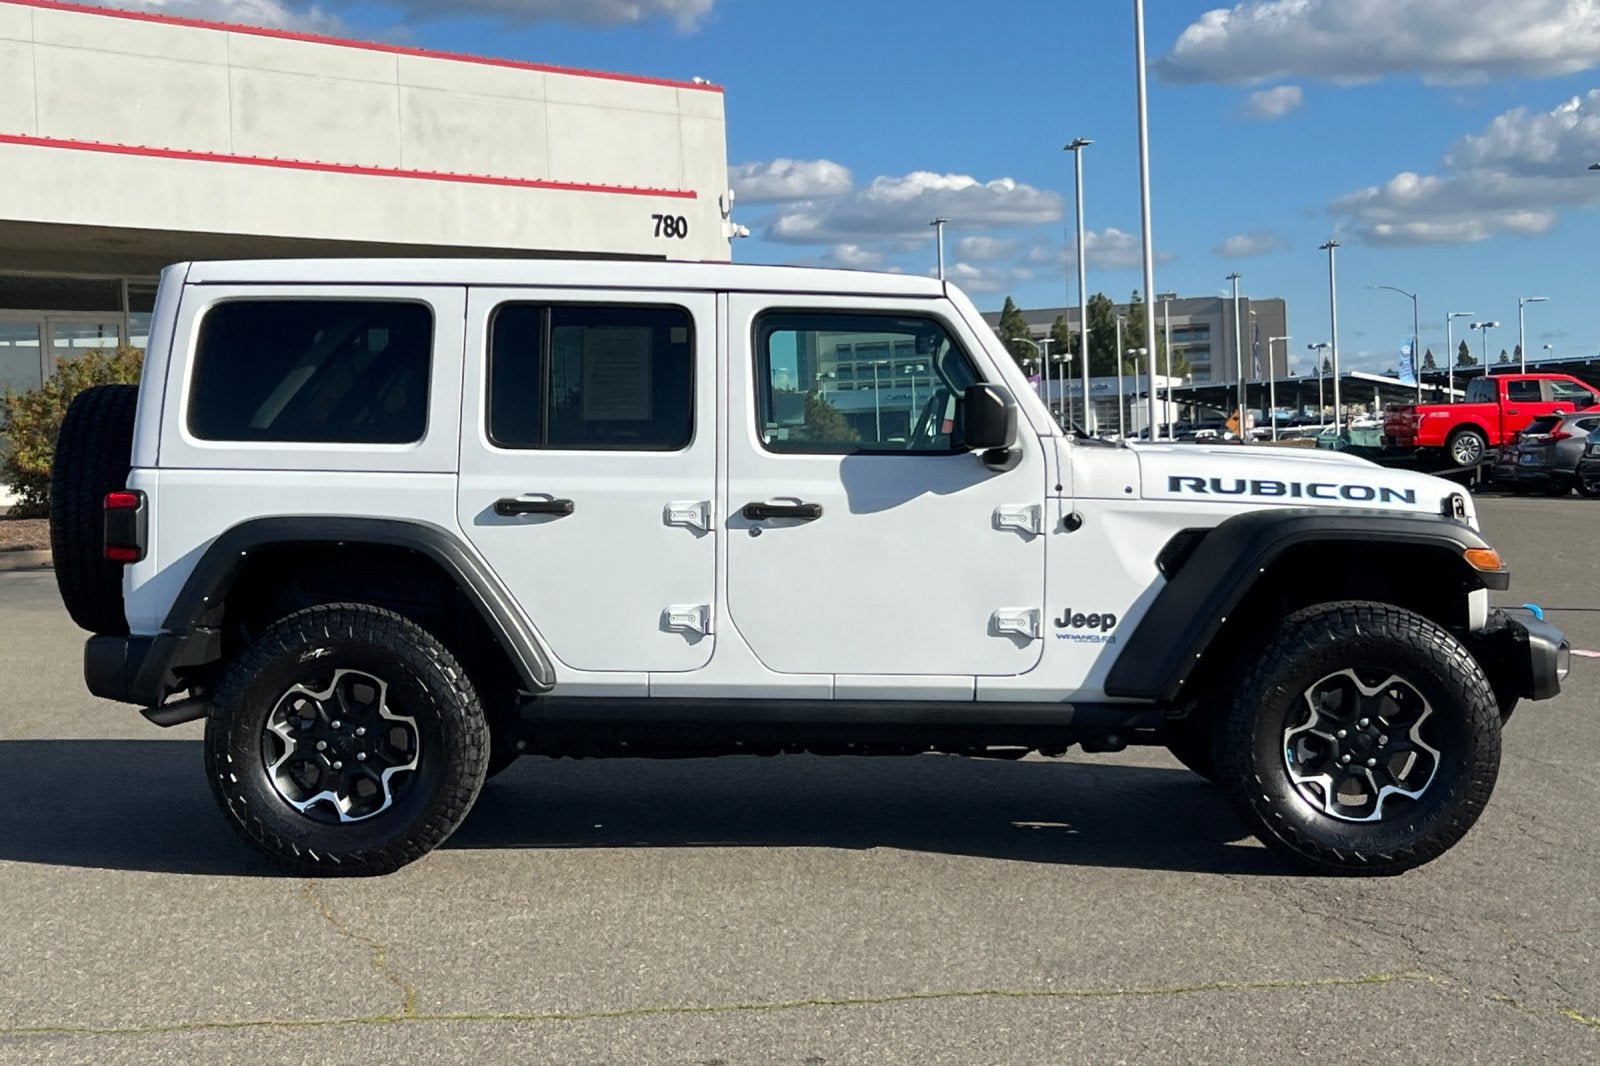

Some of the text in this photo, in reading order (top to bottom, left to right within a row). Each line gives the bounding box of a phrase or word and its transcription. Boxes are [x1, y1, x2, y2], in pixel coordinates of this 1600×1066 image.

[651, 213, 688, 239] 780
[1168, 475, 1416, 504] RUBICON
[1054, 607, 1117, 632] Jeep
